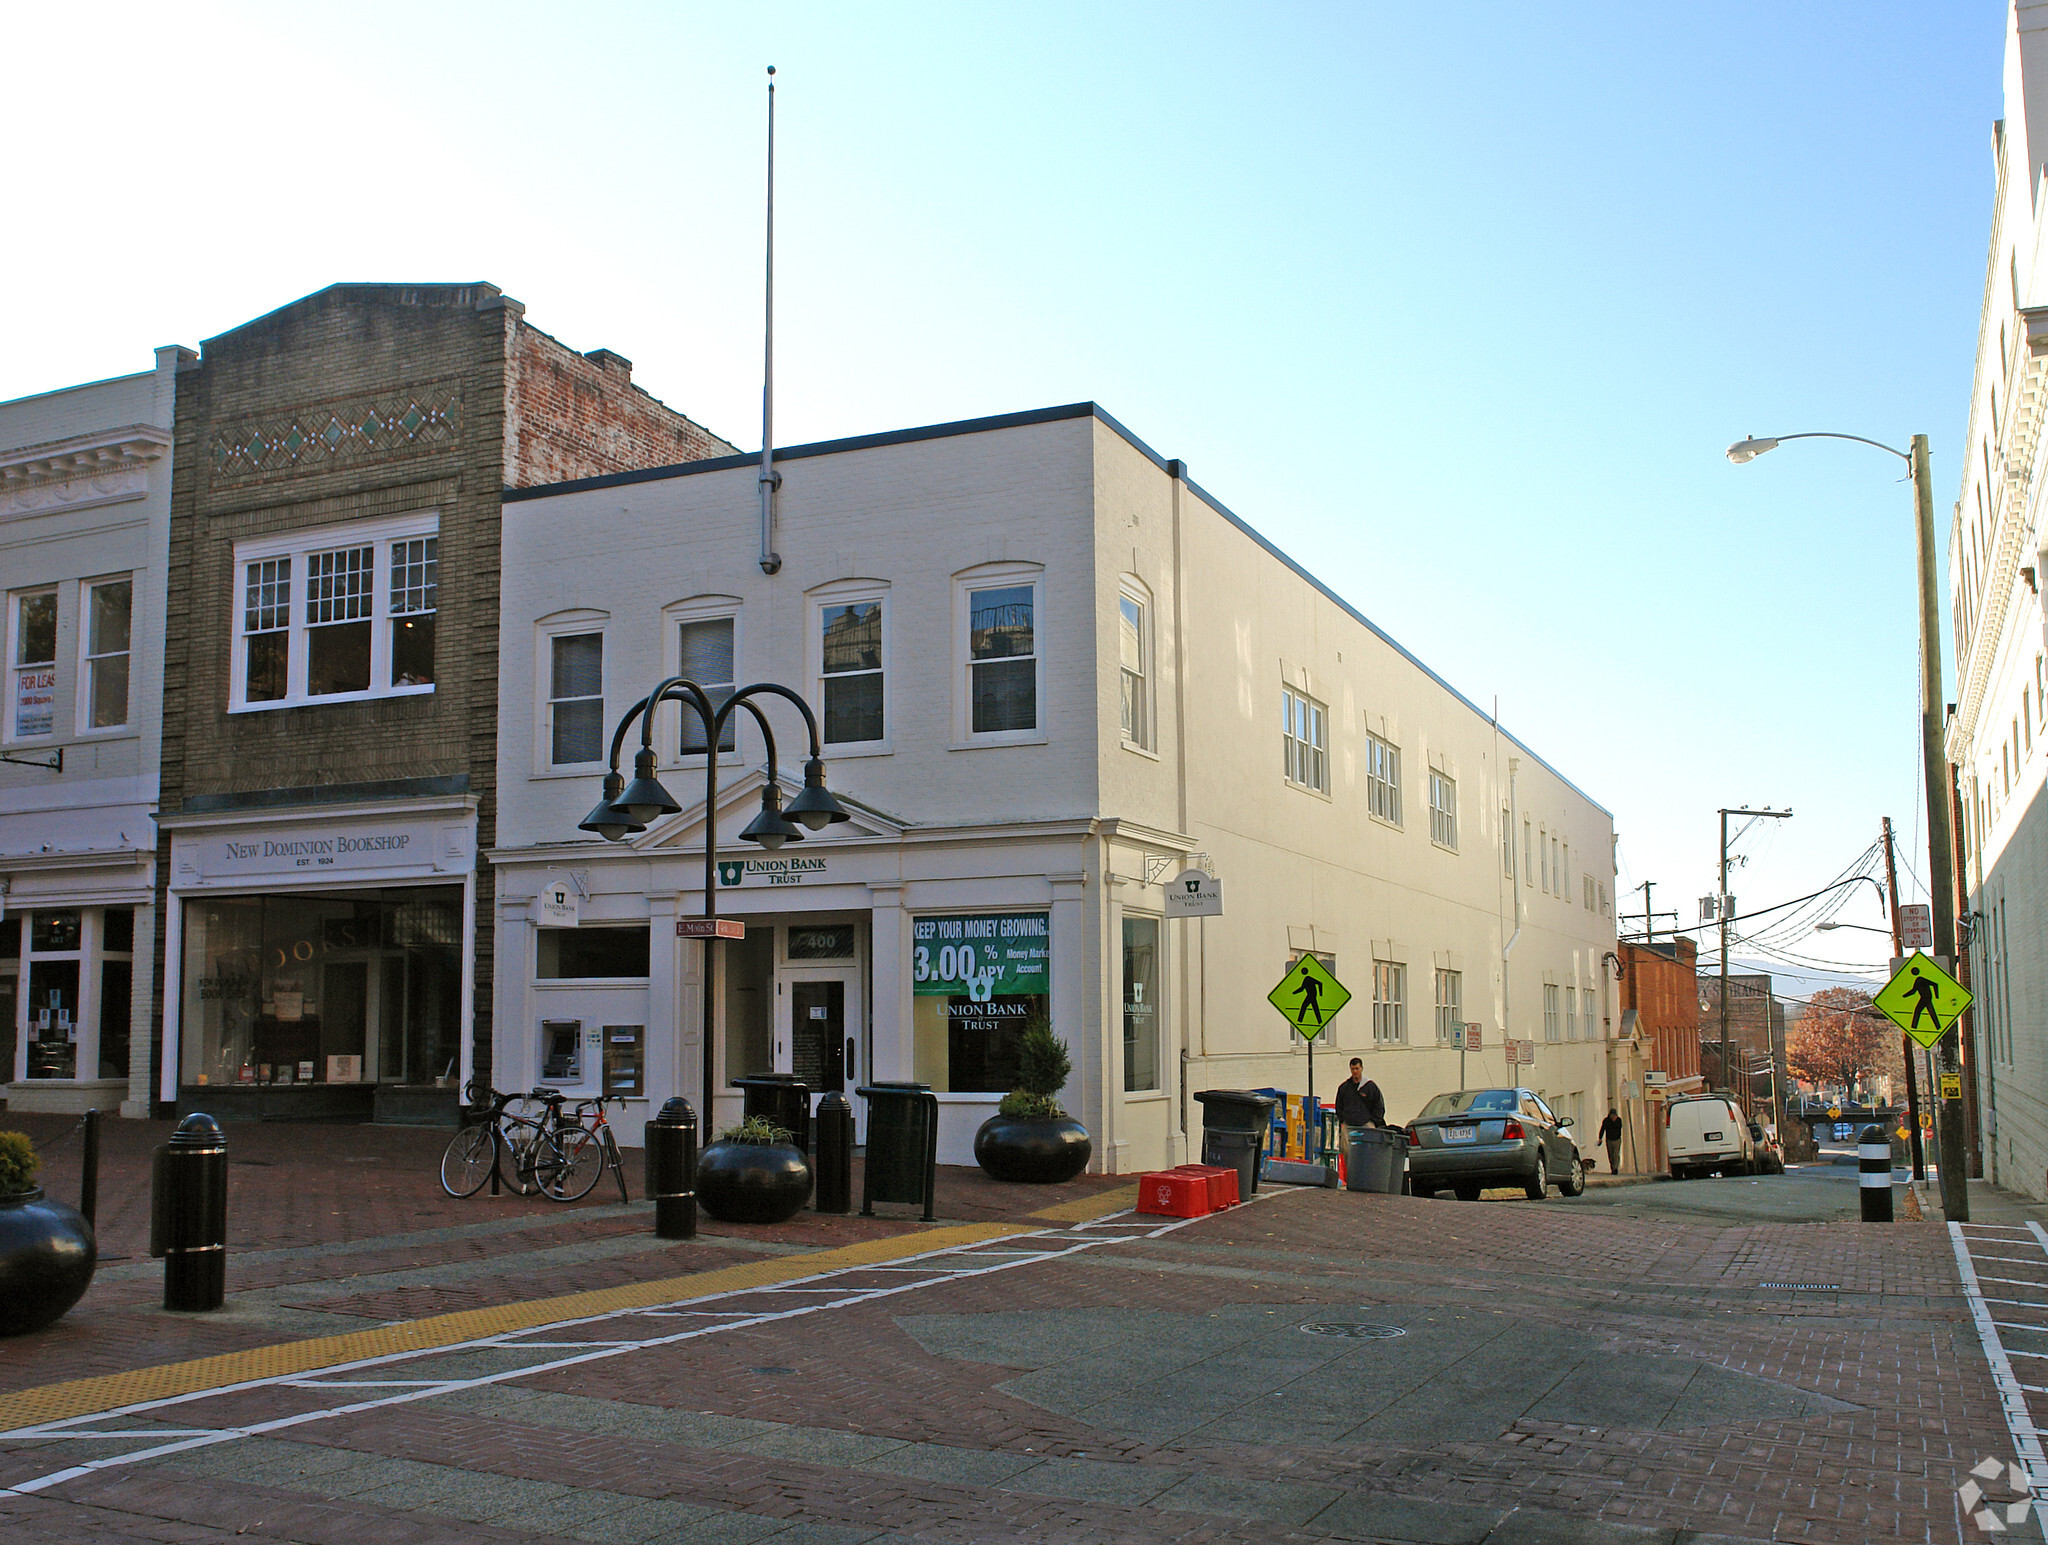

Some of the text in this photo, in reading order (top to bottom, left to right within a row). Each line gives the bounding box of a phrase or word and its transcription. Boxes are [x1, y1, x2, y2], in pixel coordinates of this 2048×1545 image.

[21, 676, 36, 689] FOR
[226, 834, 410, 859] NEW DOMINION BOOKSHOP
[318, 857, 334, 865] 1924
[745, 858, 827, 872] UNION BANK
[768, 874, 802, 884] TRUST
[1196, 892, 1218, 900] BANK
[1909, 907, 1919, 915] NO
[914, 921, 935, 939] KEEP
[938, 920, 962, 938] YOUR
[965, 919, 998, 938] MONEY
[808, 935, 836, 948] 400
[1007, 949, 1028, 960] Money
[914, 945, 976, 981] 3.00
[1016, 963, 1042, 974] Account
[979, 965, 1005, 980] APY
[937, 1003, 1027, 1016] UNION BANK
[962, 1020, 999, 1030] TRUST
